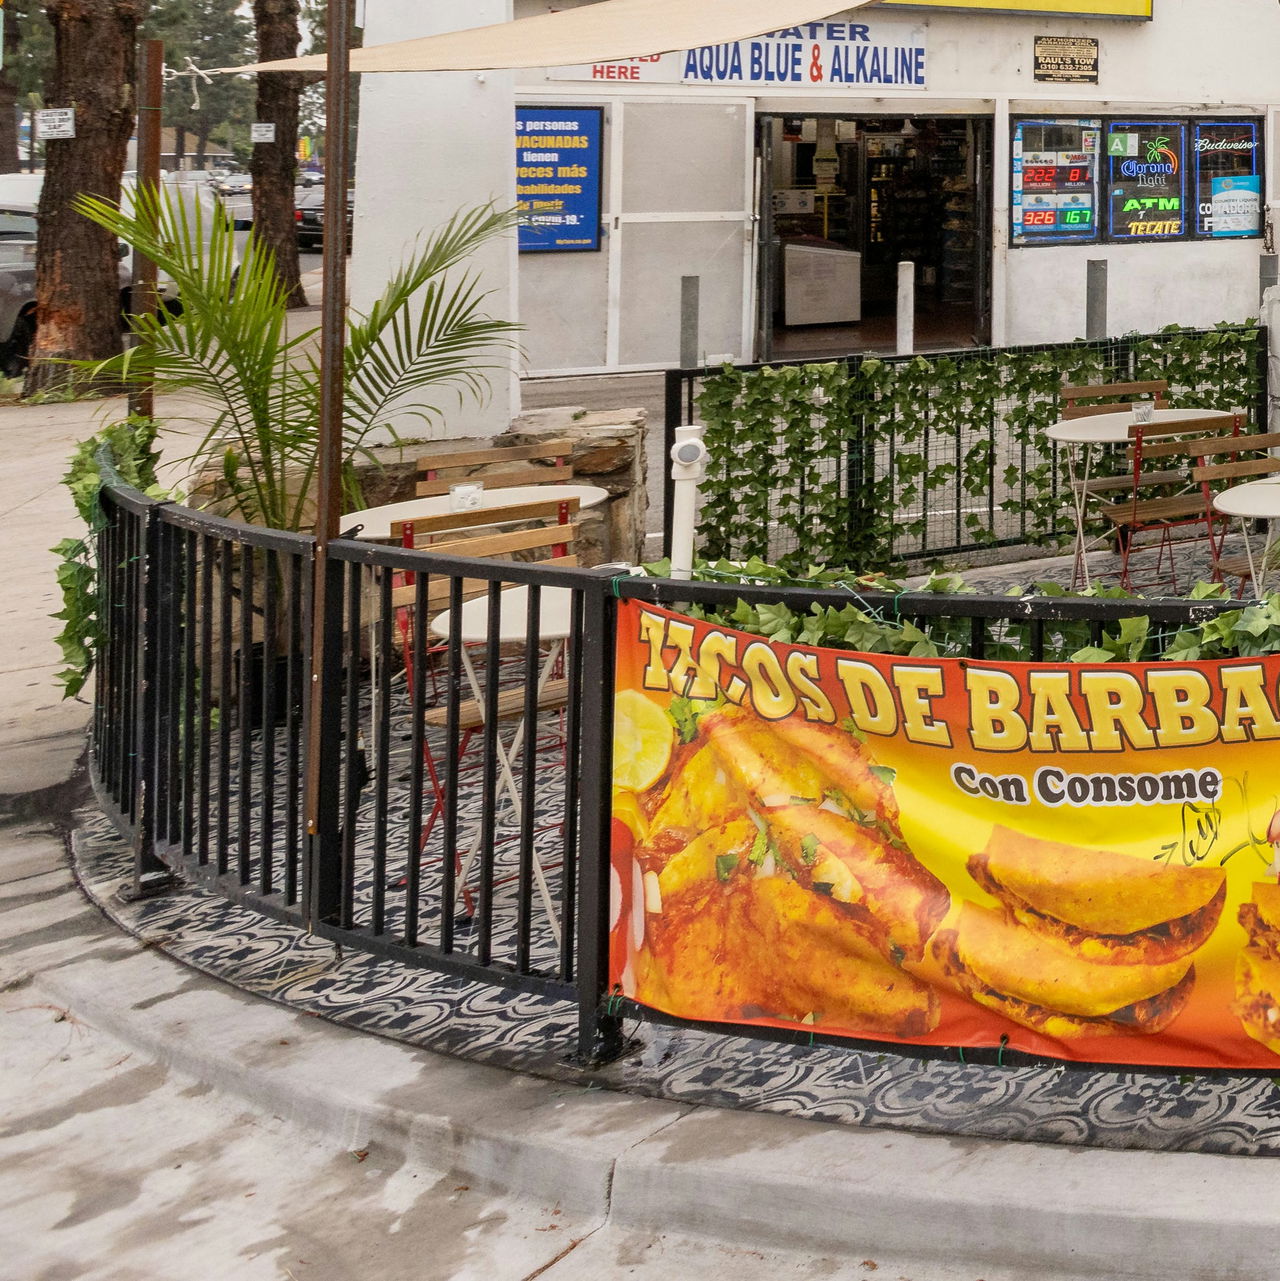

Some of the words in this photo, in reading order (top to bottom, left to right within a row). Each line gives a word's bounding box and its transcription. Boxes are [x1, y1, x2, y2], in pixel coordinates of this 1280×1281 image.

[684, 42, 743, 82] AQUA
[751, 43, 801, 83] BLUE
[809, 44, 824, 83] &
[830, 45, 925, 85] ALKALINE
[592, 65, 641, 81] HERE
[526, 121, 579, 132] personas
[1110, 138, 1123, 152] A
[1195, 138, 1259, 152] Budweiser
[523, 152, 559, 162] tienen
[558, 164, 587, 178] más
[1121, 159, 1173, 176] Corona
[1024, 169, 1056, 181] 222
[1137, 173, 1167, 187] Light
[1122, 197, 1180, 212] ATM
[1065, 211, 1091, 223] 167
[1128, 220, 1182, 235] TECATE
[836, 658, 953, 748] DE
[954, 765, 1027, 804] Con
[1036, 765, 1222, 805] Consome
